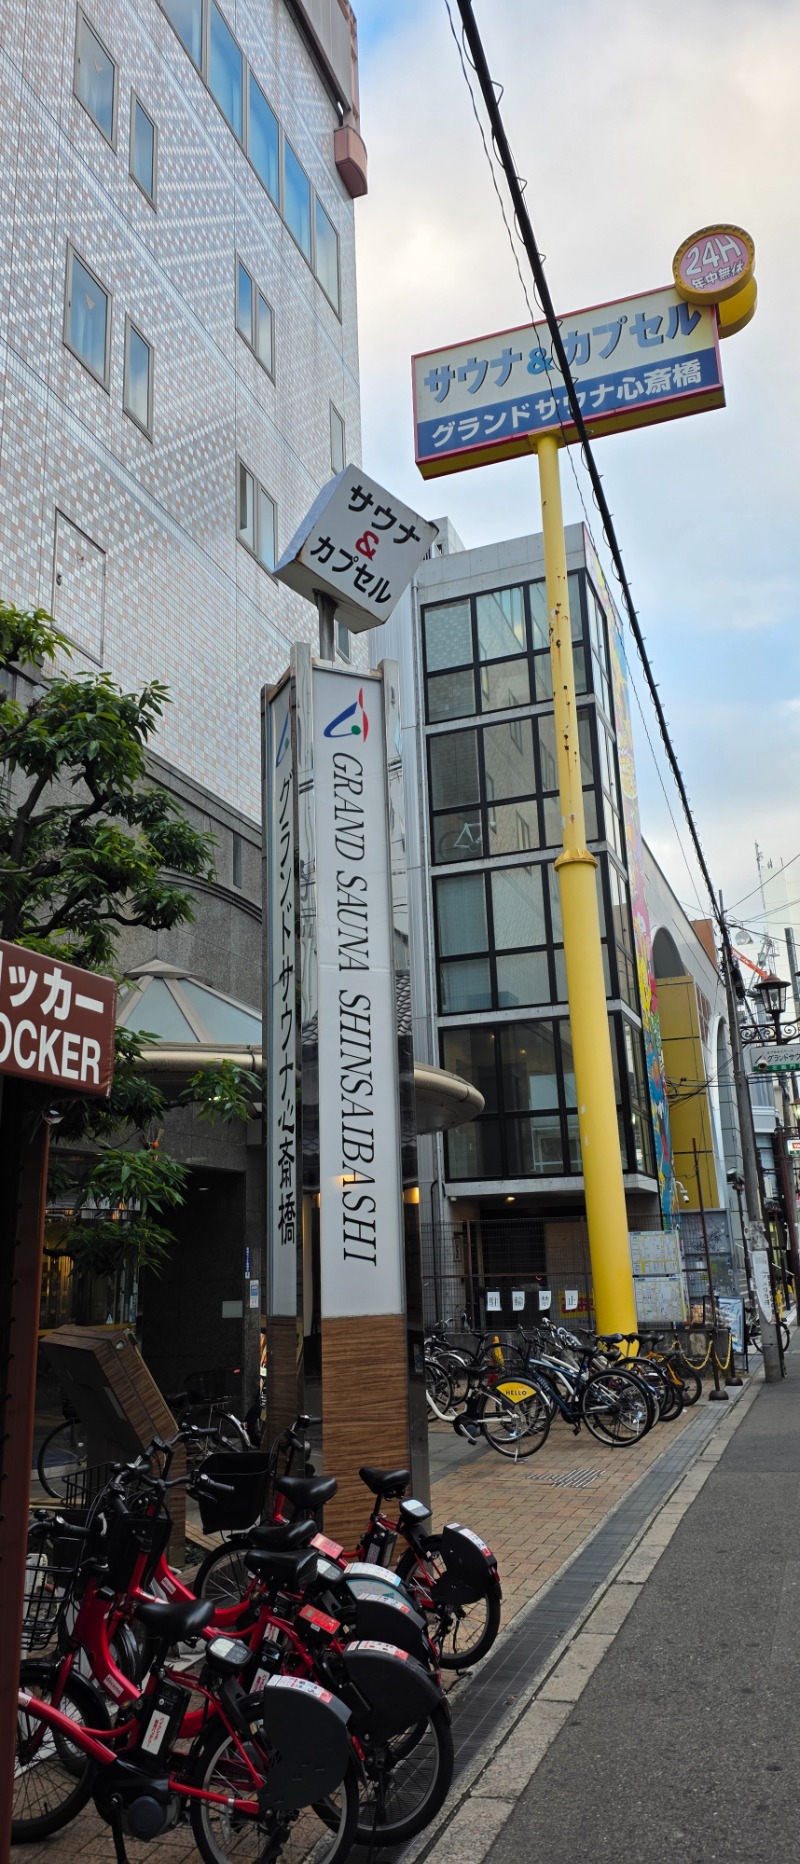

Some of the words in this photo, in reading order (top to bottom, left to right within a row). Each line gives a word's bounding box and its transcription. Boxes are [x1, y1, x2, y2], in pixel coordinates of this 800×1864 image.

[685, 234, 742, 276] 24H
[691, 260, 745, 289] 年中無休
[348, 484, 421, 544] サウナ
[355, 530, 379, 562] &
[310, 536, 392, 603] カプセル
[332, 752, 366, 861] GRAND
[336, 870, 370, 972] SAUNA
[0, 951, 104, 1021] ッカー
[278, 768, 296, 1246] グランドサウナ心斎橋
[338, 989, 377, 1267] SHINSAIBASHI
